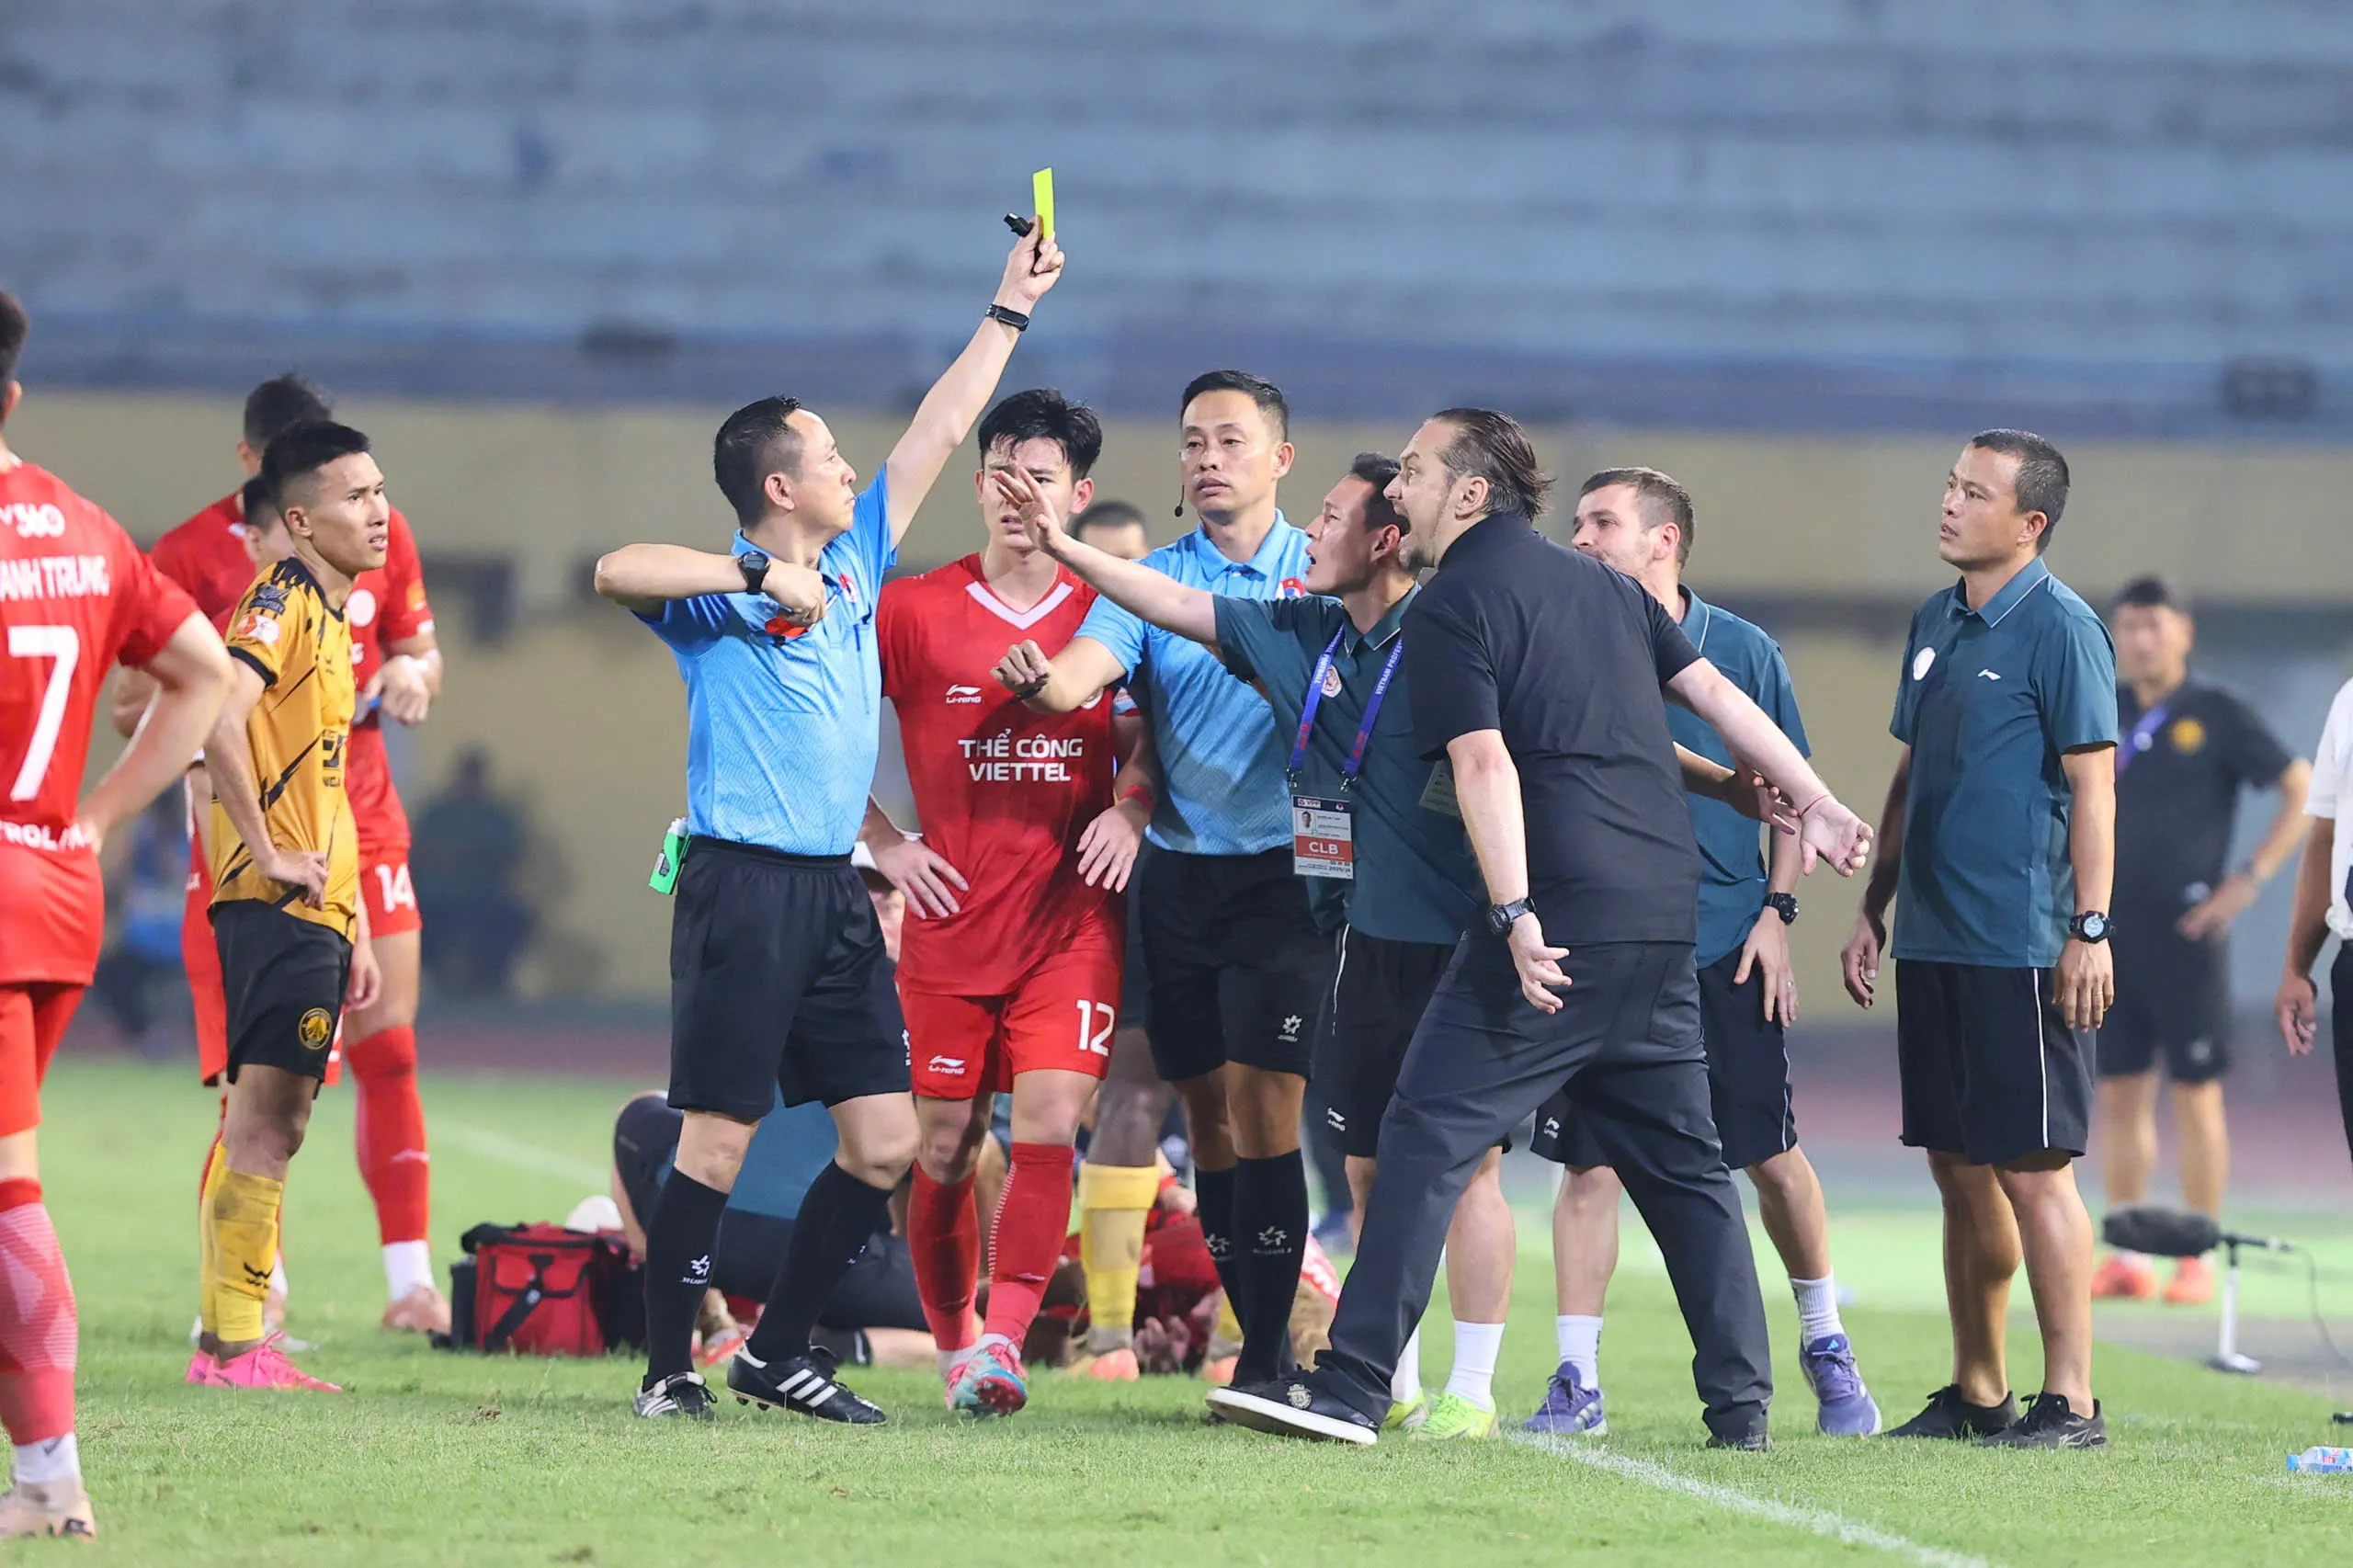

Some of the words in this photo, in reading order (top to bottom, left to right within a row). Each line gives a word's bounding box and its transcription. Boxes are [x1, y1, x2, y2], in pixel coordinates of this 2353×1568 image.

[8, 625, 79, 801] 7
[957, 728, 1012, 758] THỂ
[1016, 733, 1083, 758] CÔNG
[969, 762, 1072, 781] VIETTEL
[1309, 842, 1338, 854] CLB
[374, 862, 417, 914] 14
[1076, 999, 1115, 1057] 12
